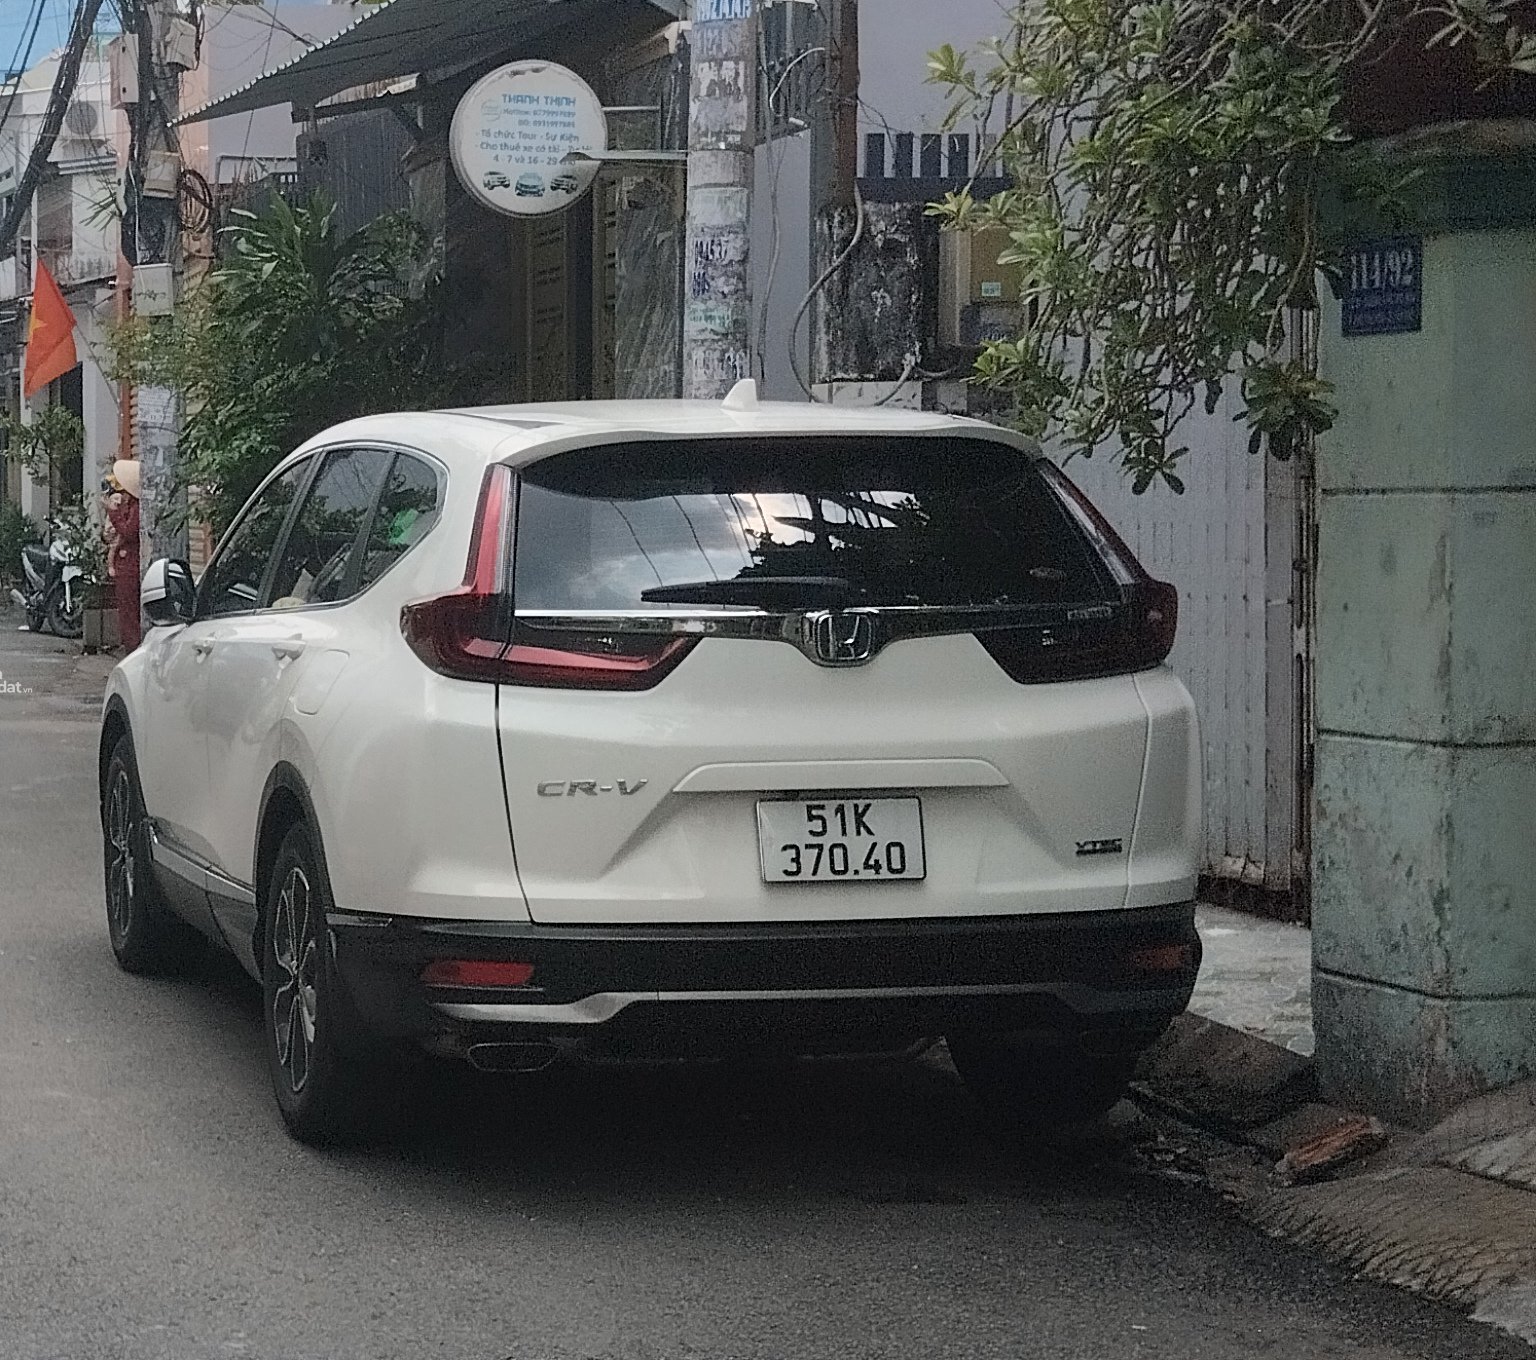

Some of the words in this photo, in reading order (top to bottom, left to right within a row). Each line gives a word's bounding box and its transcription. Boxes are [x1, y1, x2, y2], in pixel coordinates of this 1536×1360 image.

[502, 93, 540, 105] THANH
[481, 128, 492, 138] Tổ
[493, 130, 515, 140] chức
[518, 130, 537, 140] Tour
[559, 133, 580, 143] Kiện
[479, 141, 497, 150] Cho
[499, 141, 521, 151] thuê
[514, 154, 525, 164] và
[528, 155, 538, 164] 16
[547, 157, 557, 166] 29
[537, 778, 648, 797] CR-V
[806, 803, 875, 837] 51K
[780, 841, 906, 877] 370.40
